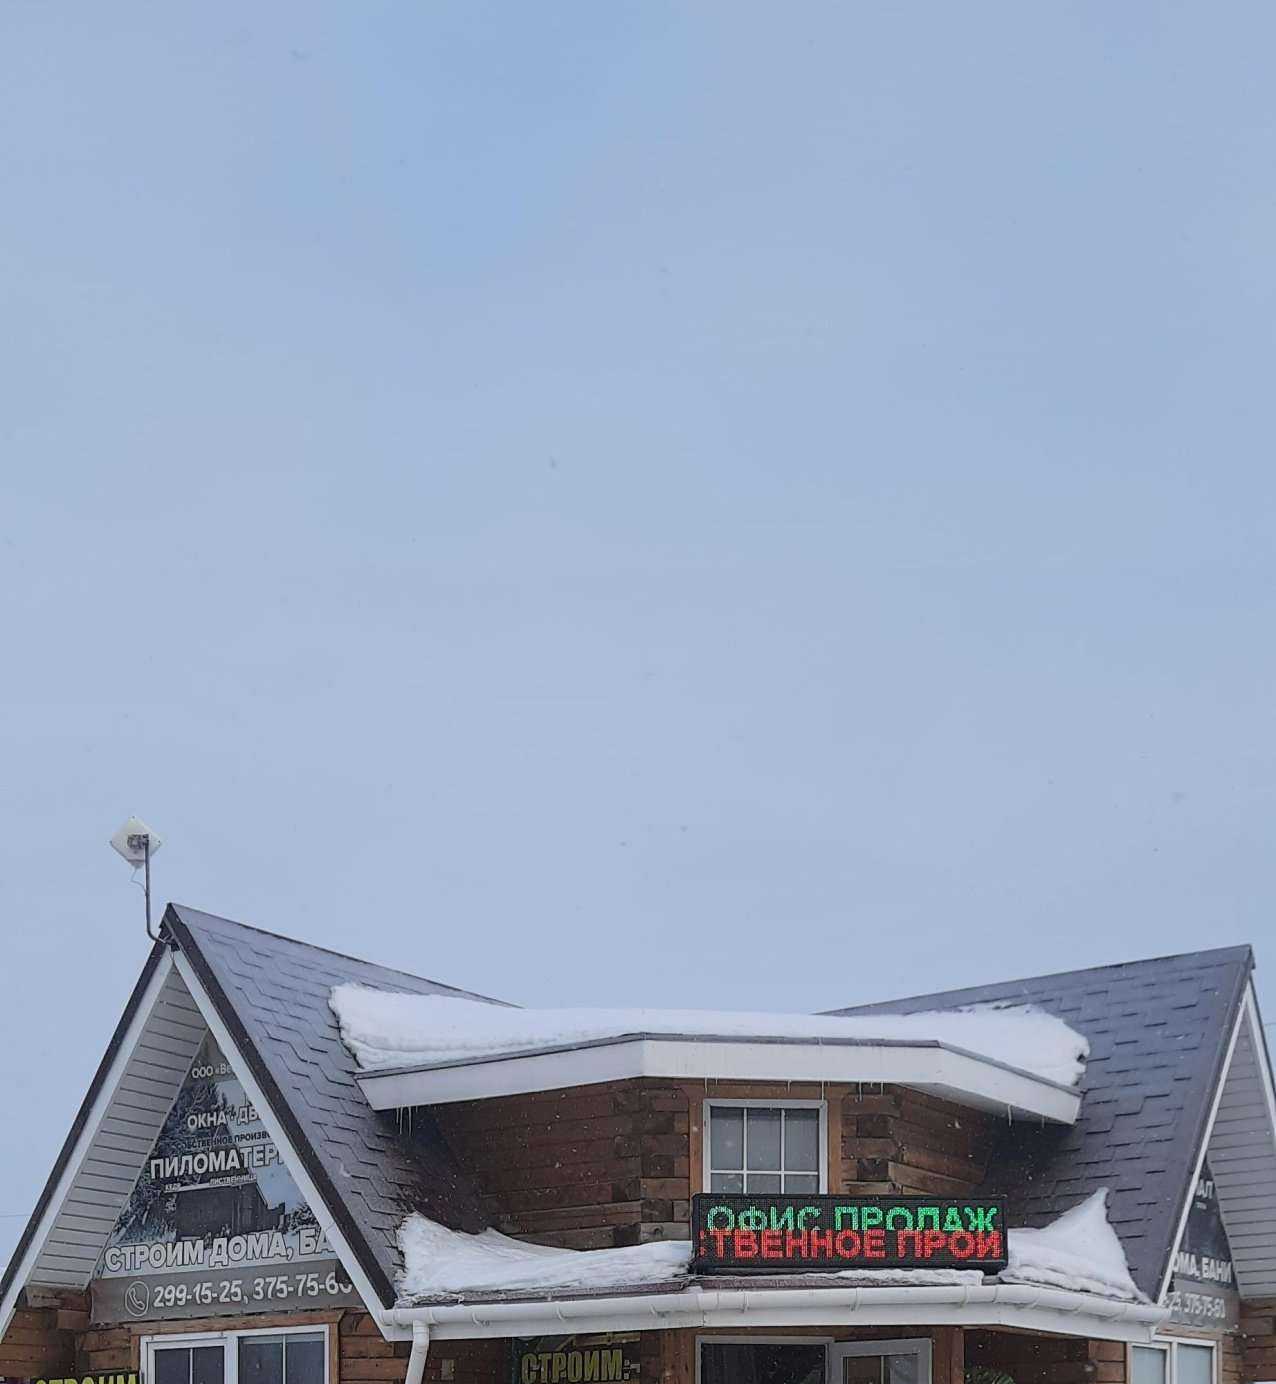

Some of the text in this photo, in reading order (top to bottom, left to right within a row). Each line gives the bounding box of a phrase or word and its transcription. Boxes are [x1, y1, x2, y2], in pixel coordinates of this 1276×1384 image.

[191, 1065, 214, 1079] ООО
[187, 1109, 228, 1129] ОКНА
[707, 1205, 822, 1231] ОФИС
[104, 1239, 206, 1273] СТРОИМ
[208, 1231, 294, 1268] ДОМА,
[700, 1229, 887, 1258] ТВЕННОЕ
[1201, 1256, 1233, 1284] БАНИ
[152, 1278, 249, 1309] 299-15-25,
